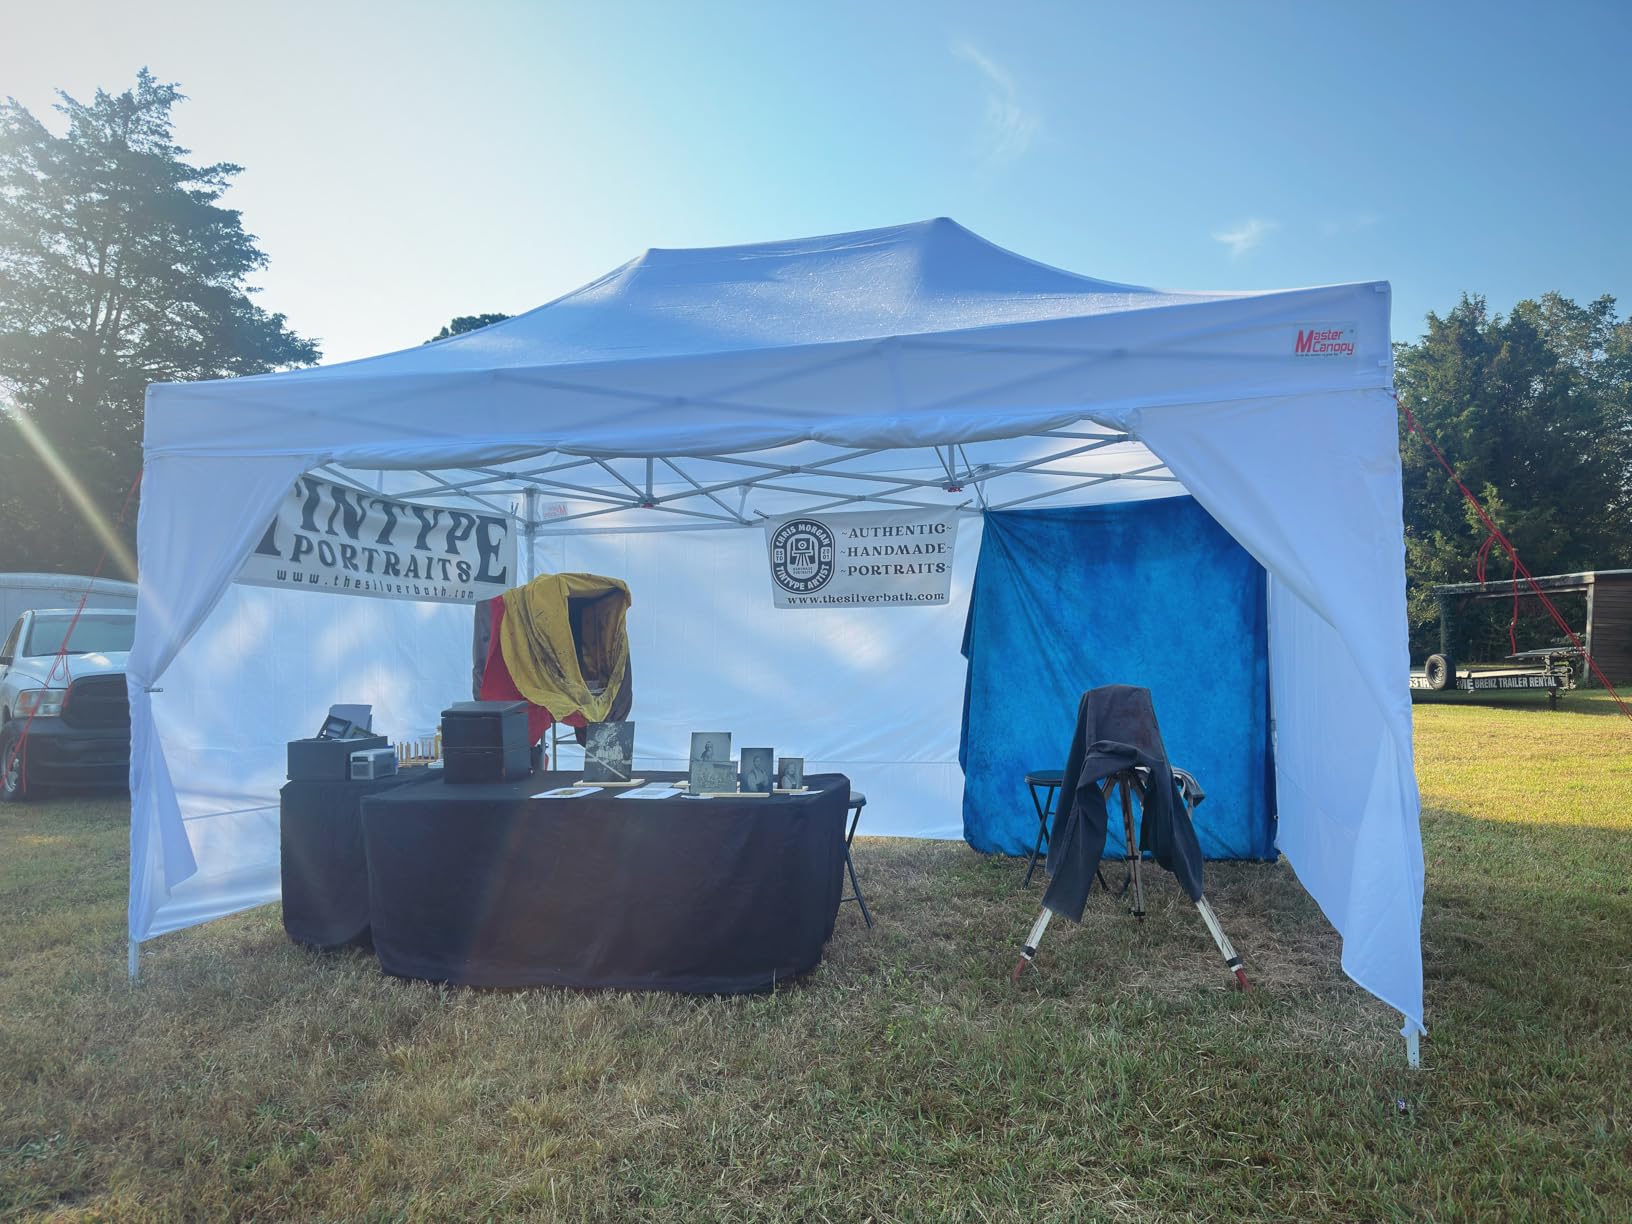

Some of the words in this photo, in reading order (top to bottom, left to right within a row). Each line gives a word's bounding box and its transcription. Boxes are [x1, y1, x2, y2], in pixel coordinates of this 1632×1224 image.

[1295, 329, 1344, 353] Master
[1312, 341, 1355, 356] Canopy
[775, 526, 797, 547] CHRIS
[798, 523, 831, 546] MORGAN
[288, 533, 473, 583] PORTRAITS
[848, 543, 947, 557] HANDMADE
[775, 565, 805, 590] TINTYPE
[807, 564, 830, 590] ARTIST
[848, 562, 946, 576] PORTRAITS
[276, 568, 475, 600] www.thesilverbath.com
[787, 592, 945, 604] www.thesilverbath.com
[1498, 677, 1529, 689] TRAILER
[1529, 676, 1557, 687] RENTAL
